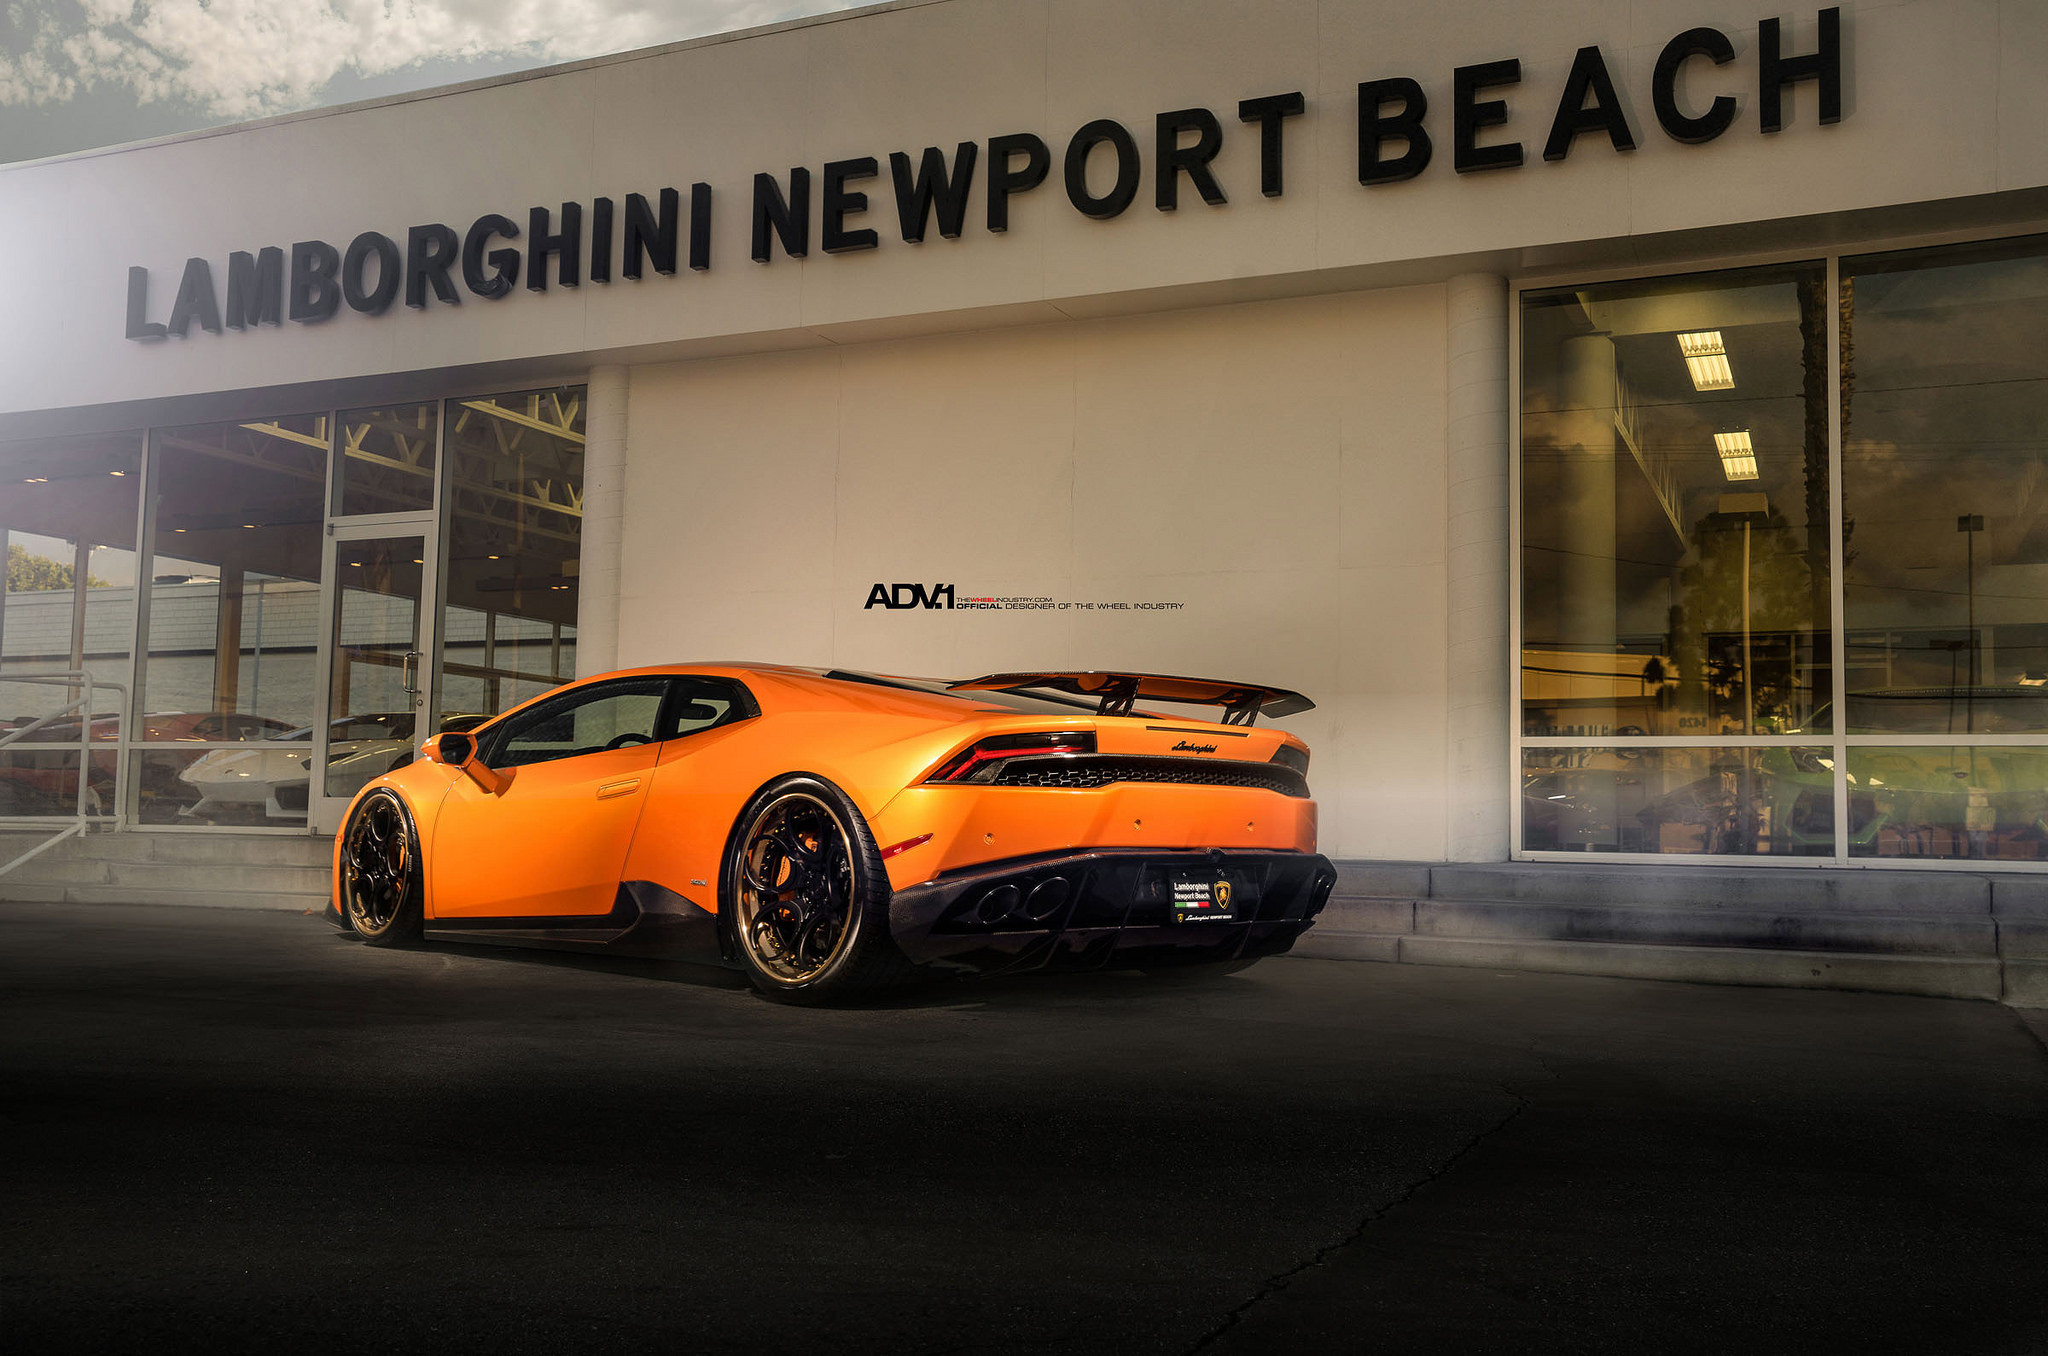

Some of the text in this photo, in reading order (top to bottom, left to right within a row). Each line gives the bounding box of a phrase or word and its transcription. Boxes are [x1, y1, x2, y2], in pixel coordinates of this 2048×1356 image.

[125, 6, 1842, 342] LAMBORGHINI NEWPORT BEACH
[1171, 741, 1217, 754] Lamborghini
[1174, 882, 1209, 892] Lamborghini
[1174, 892, 1210, 901] Newport Beach
